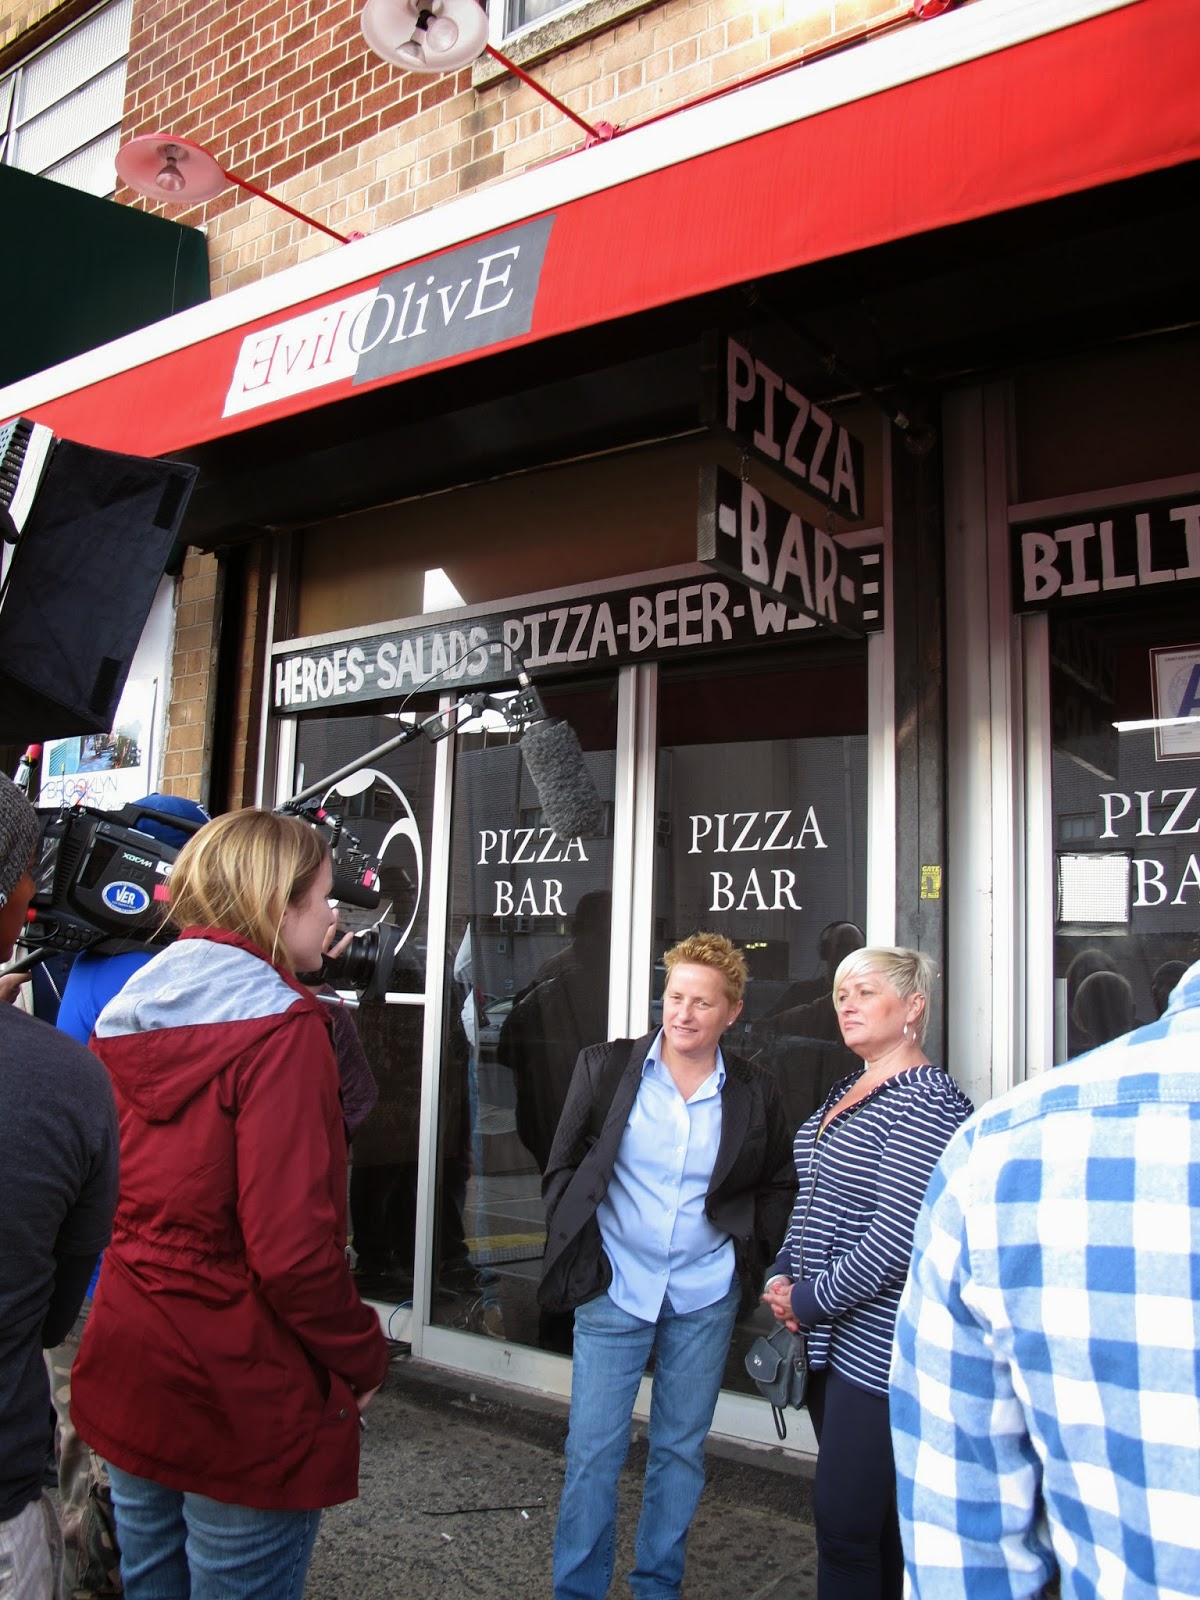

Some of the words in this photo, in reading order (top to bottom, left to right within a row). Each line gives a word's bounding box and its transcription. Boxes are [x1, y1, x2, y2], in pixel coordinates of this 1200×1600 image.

[727, 335, 859, 517] PIZZA
[477, 827, 589, 866] PIZZA
[688, 805, 828, 854] PIZZA
[115, 885, 136, 906] VER
[493, 877, 568, 917] BAR
[709, 867, 802, 912] BAR
